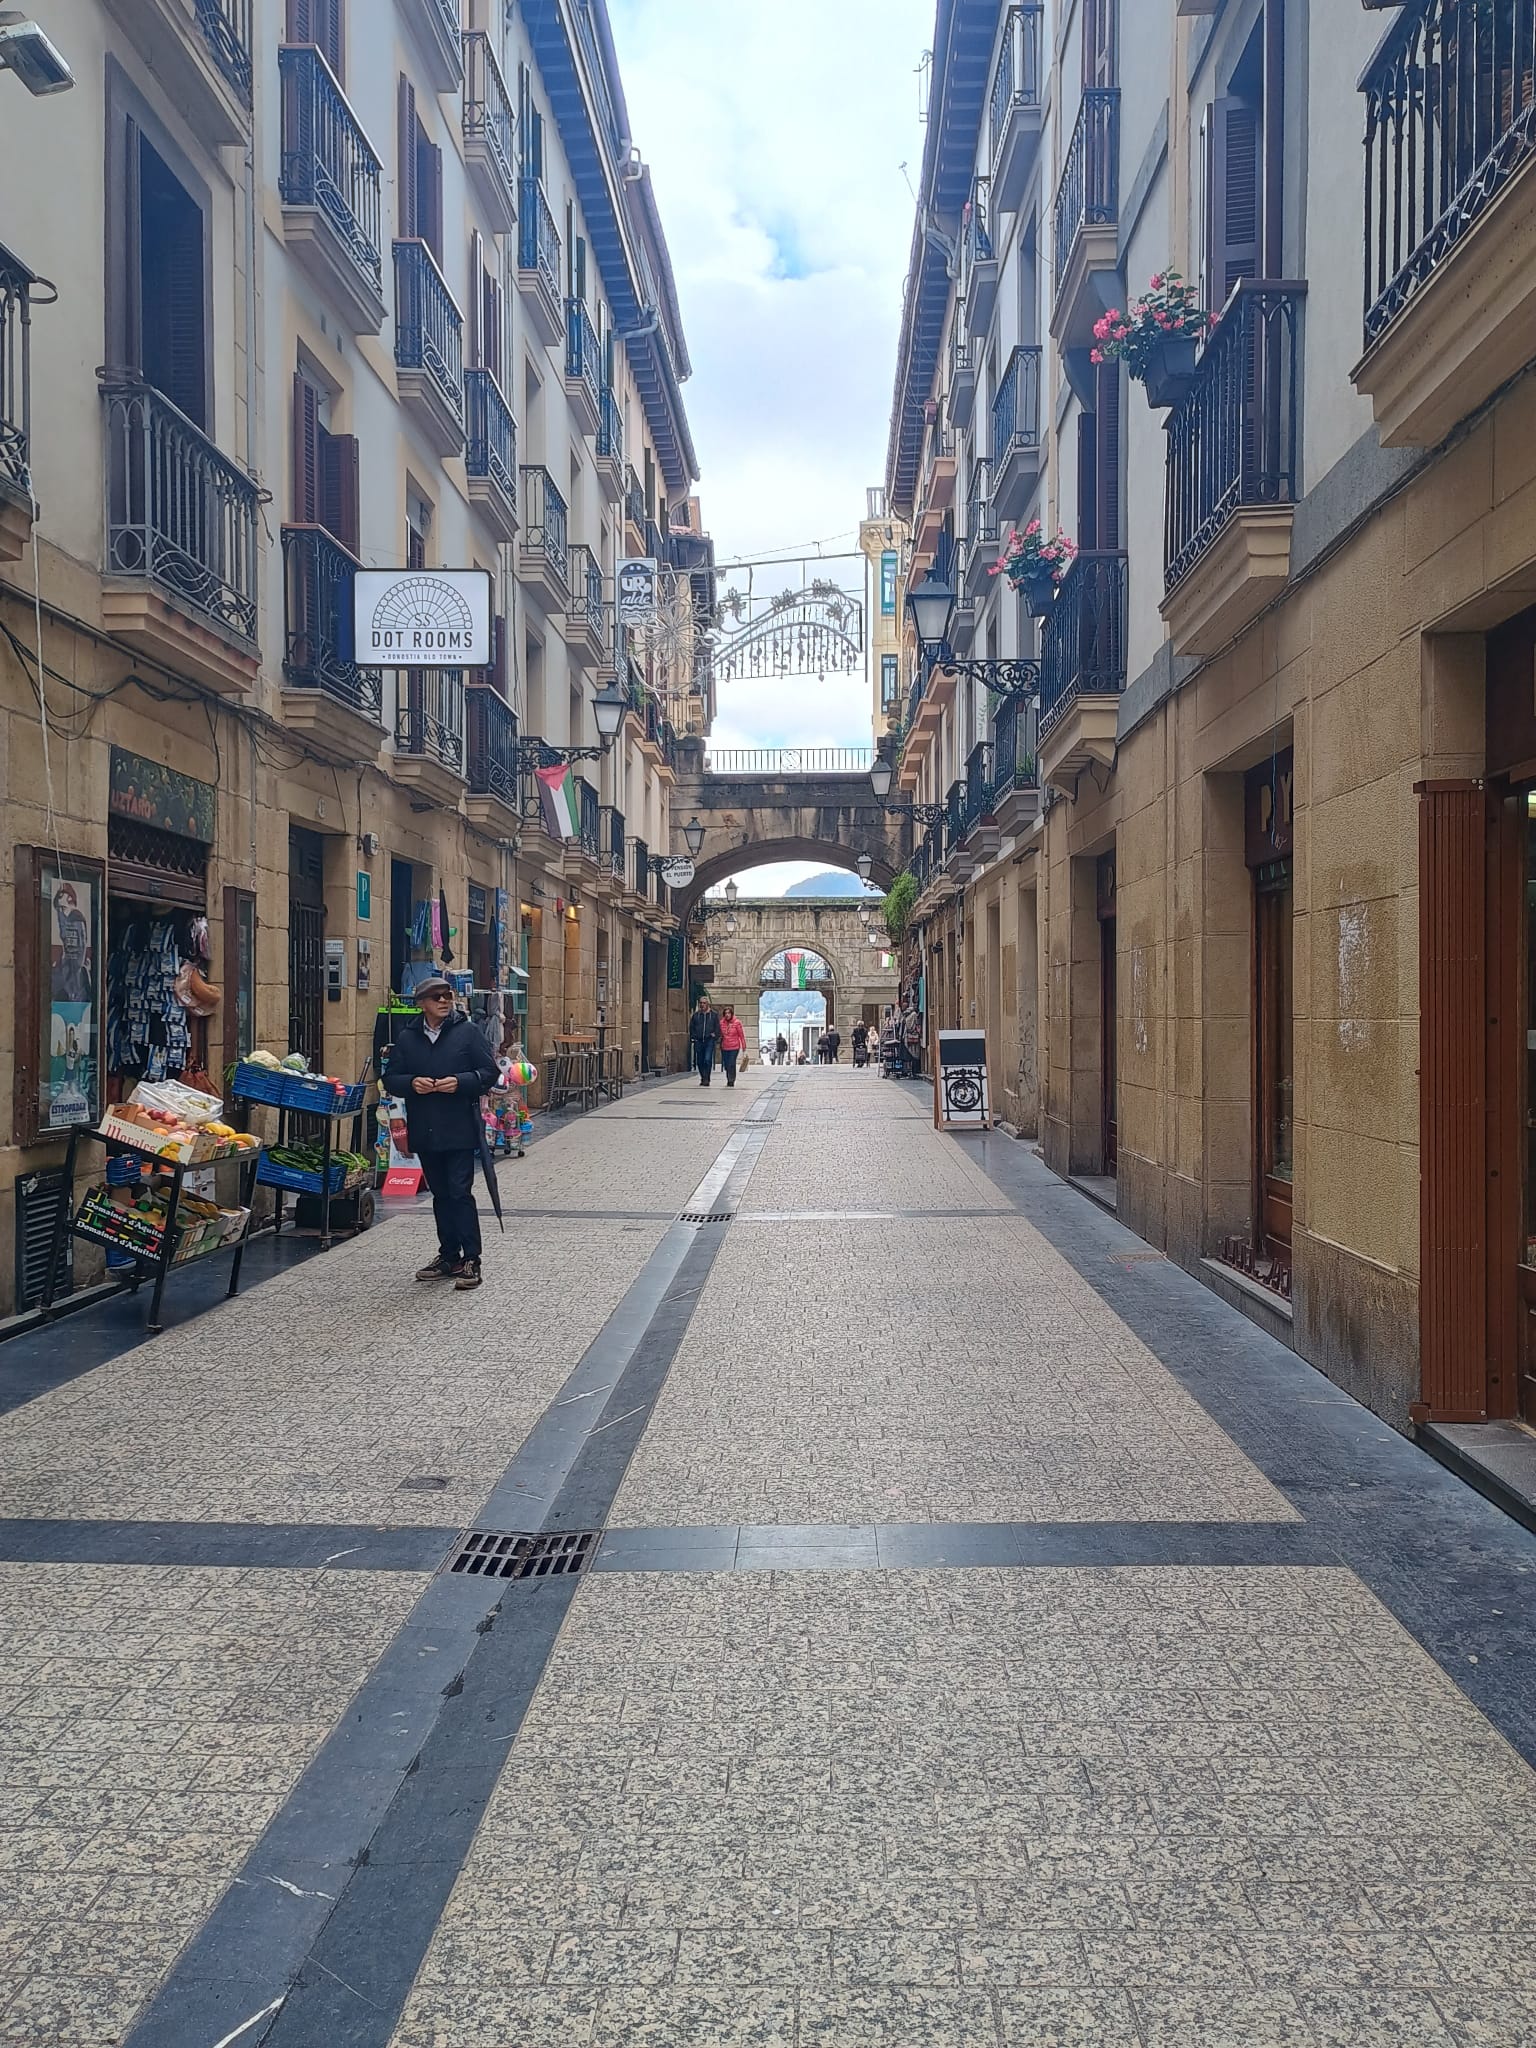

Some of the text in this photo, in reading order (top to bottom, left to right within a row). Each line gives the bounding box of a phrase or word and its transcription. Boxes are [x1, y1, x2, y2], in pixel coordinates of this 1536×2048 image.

[622, 592, 651, 605] alde
[372, 631, 473, 648] DOT ROOMS
[361, 877, 368, 902] P
[105, 1123, 157, 1154] Morales
[388, 1177, 416, 1186] Coca-Cola
[86, 1200, 127, 1223] Domaines
[76, 1220, 161, 1261] Domaines d'Aquitain
